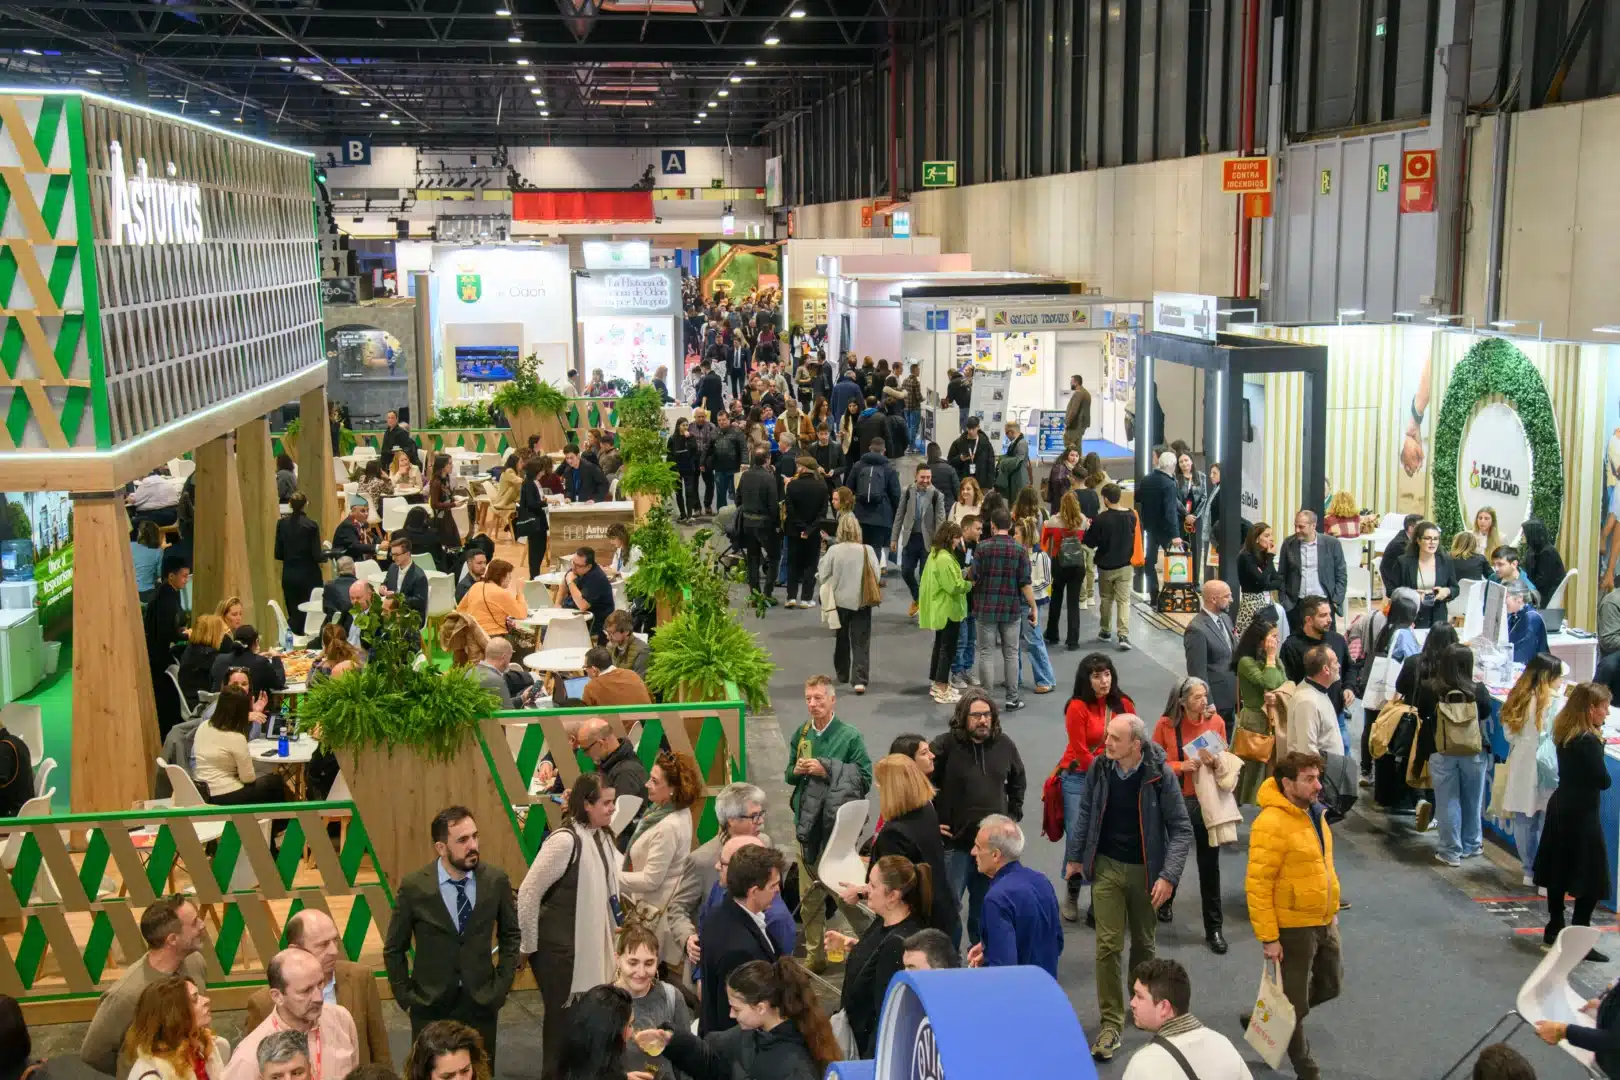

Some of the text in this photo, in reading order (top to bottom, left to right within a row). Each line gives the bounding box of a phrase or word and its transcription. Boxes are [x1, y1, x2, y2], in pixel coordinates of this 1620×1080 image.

[348, 140, 364, 161] B
[666, 153, 682, 171] A
[1233, 162, 1259, 170] EQUIPO
[1227, 180, 1264, 188] INCENDIOS
[1231, 171, 1260, 179] CONTRA
[110, 140, 203, 246] Asturias
[1480, 477, 1520, 497] IGUALDAD
[1241, 491, 1258, 510] sible
[586, 524, 609, 534] Astur
